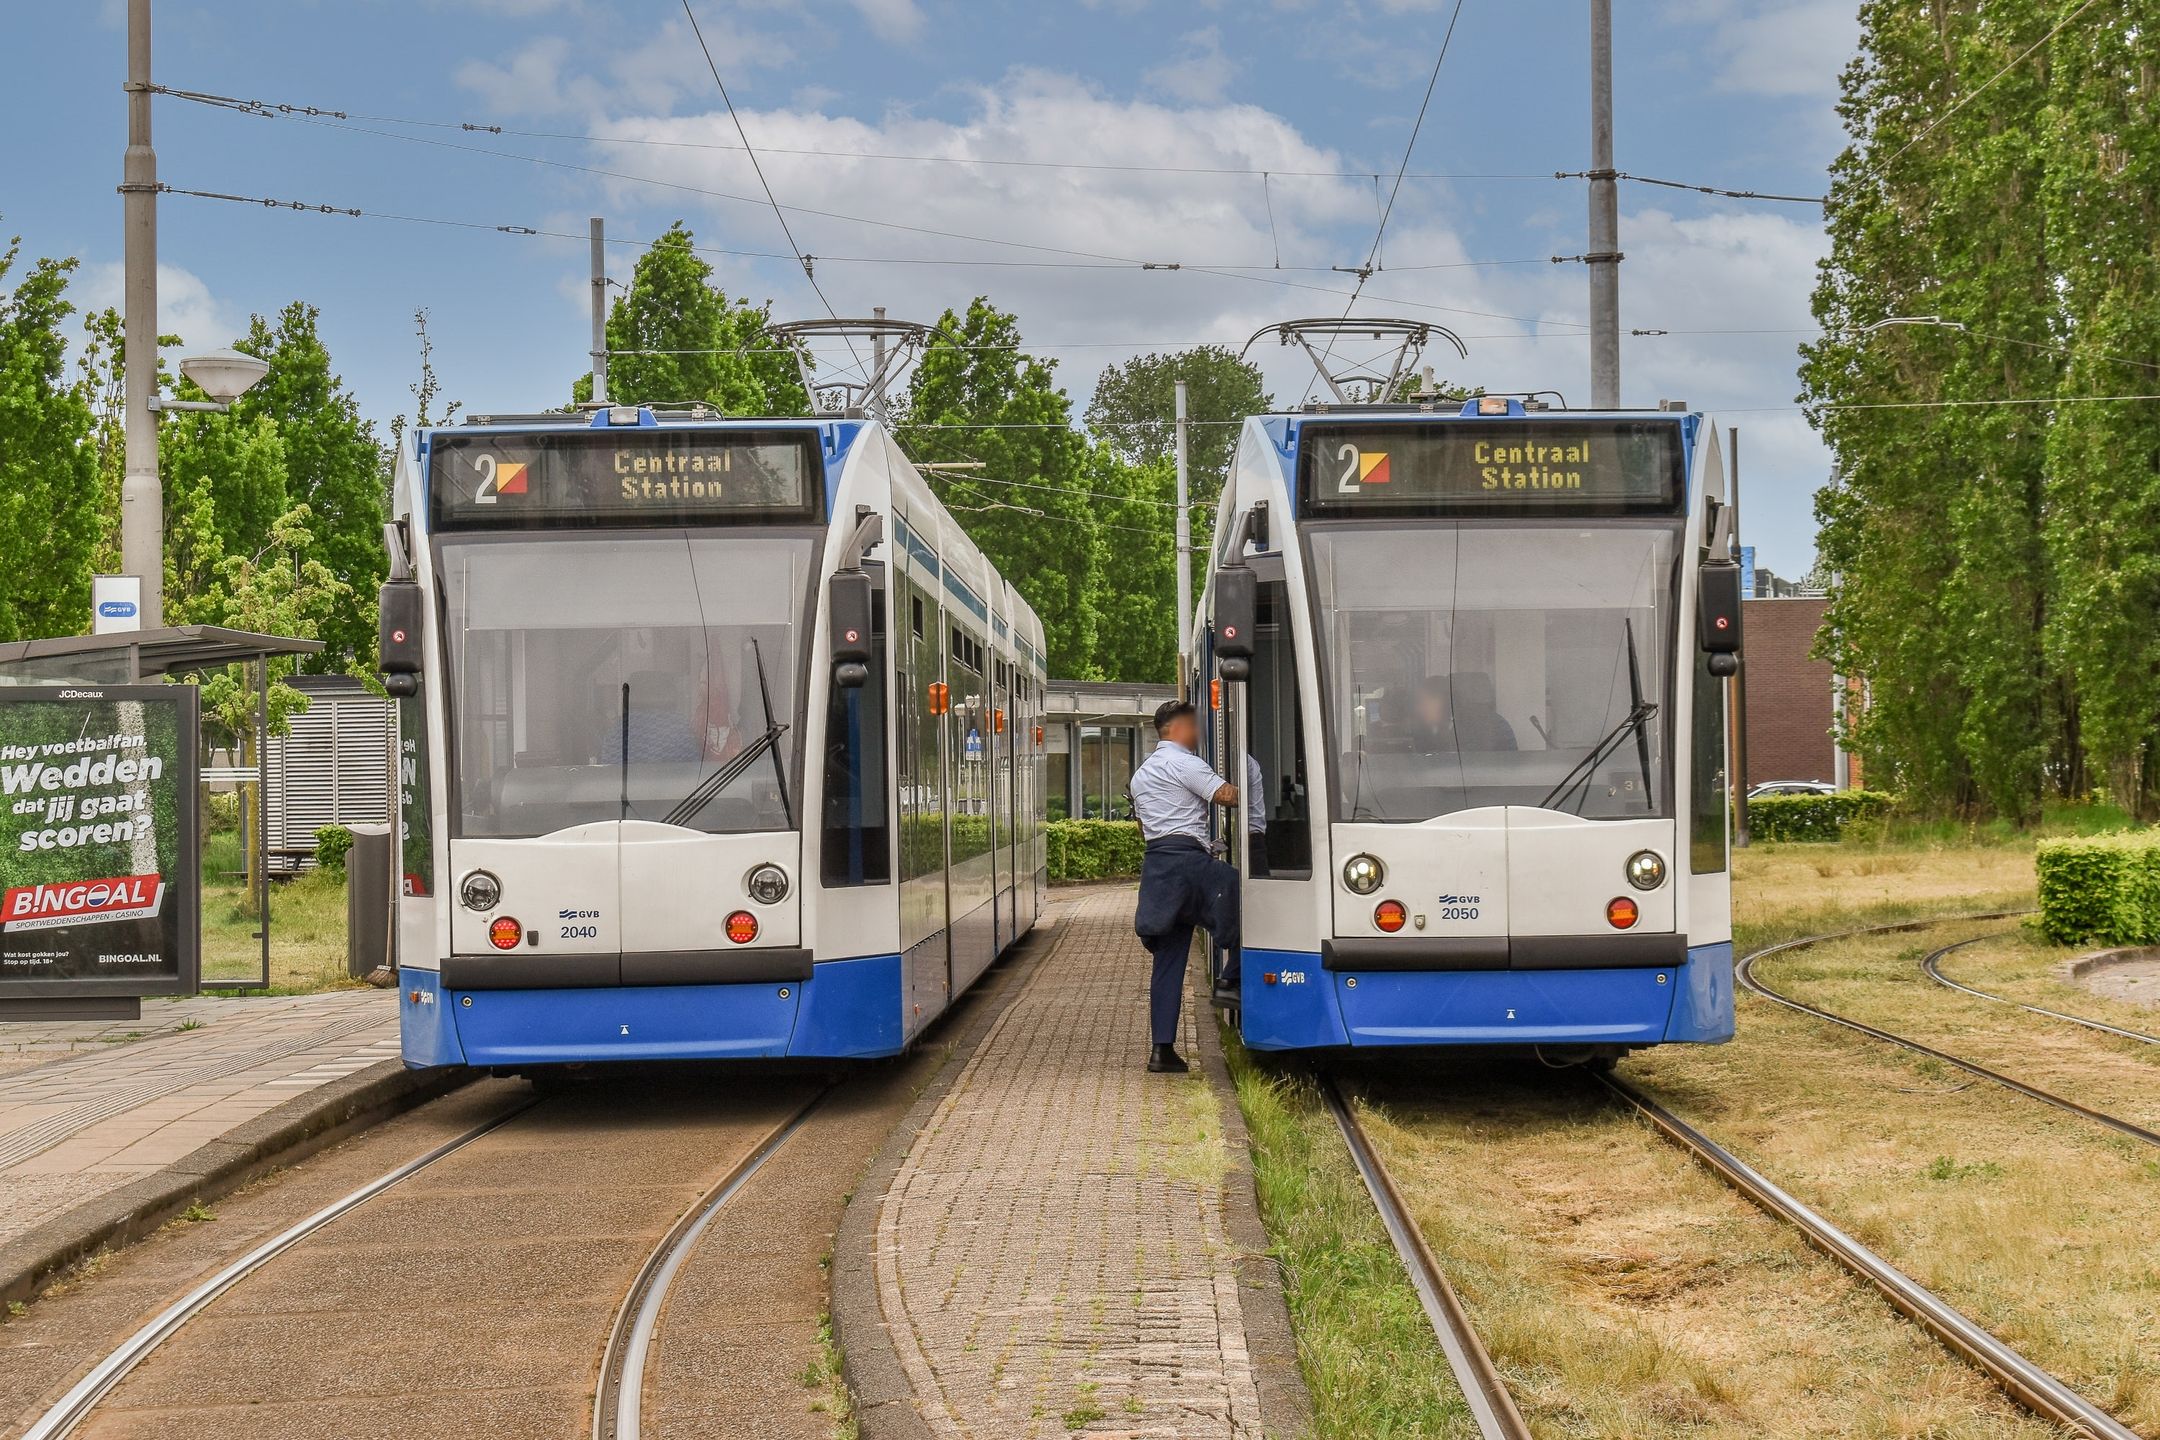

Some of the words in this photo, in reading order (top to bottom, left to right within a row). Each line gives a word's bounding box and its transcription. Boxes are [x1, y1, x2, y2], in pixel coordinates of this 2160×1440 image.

[614, 450, 731, 474] Centraal
[1474, 440, 1589, 464] Centraal
[474, 454, 497, 504] 2
[1338, 443, 1360, 493] 2
[1482, 466, 1581, 490] Station
[622, 475, 722, 500] Station
[58, 690, 104, 699] JCDecaux
[1, 744, 40, 761] Hey
[1, 754, 163, 795] Wedden
[13, 798, 46, 815] dat
[44, 795, 76, 824] jij
[79, 789, 147, 820] gaat
[18, 815, 154, 851] scoren?
[15, 914, 110, 929] SPORTWEDDENSCHAPPEN
[115, 909, 144, 919] CASINO
[1442, 908, 1479, 919] 2050
[561, 926, 597, 938] 2040
[32, 951, 55, 959] gokken
[98, 953, 163, 964] BINGOAL.NL
[1292, 972, 1305, 983] GVB
